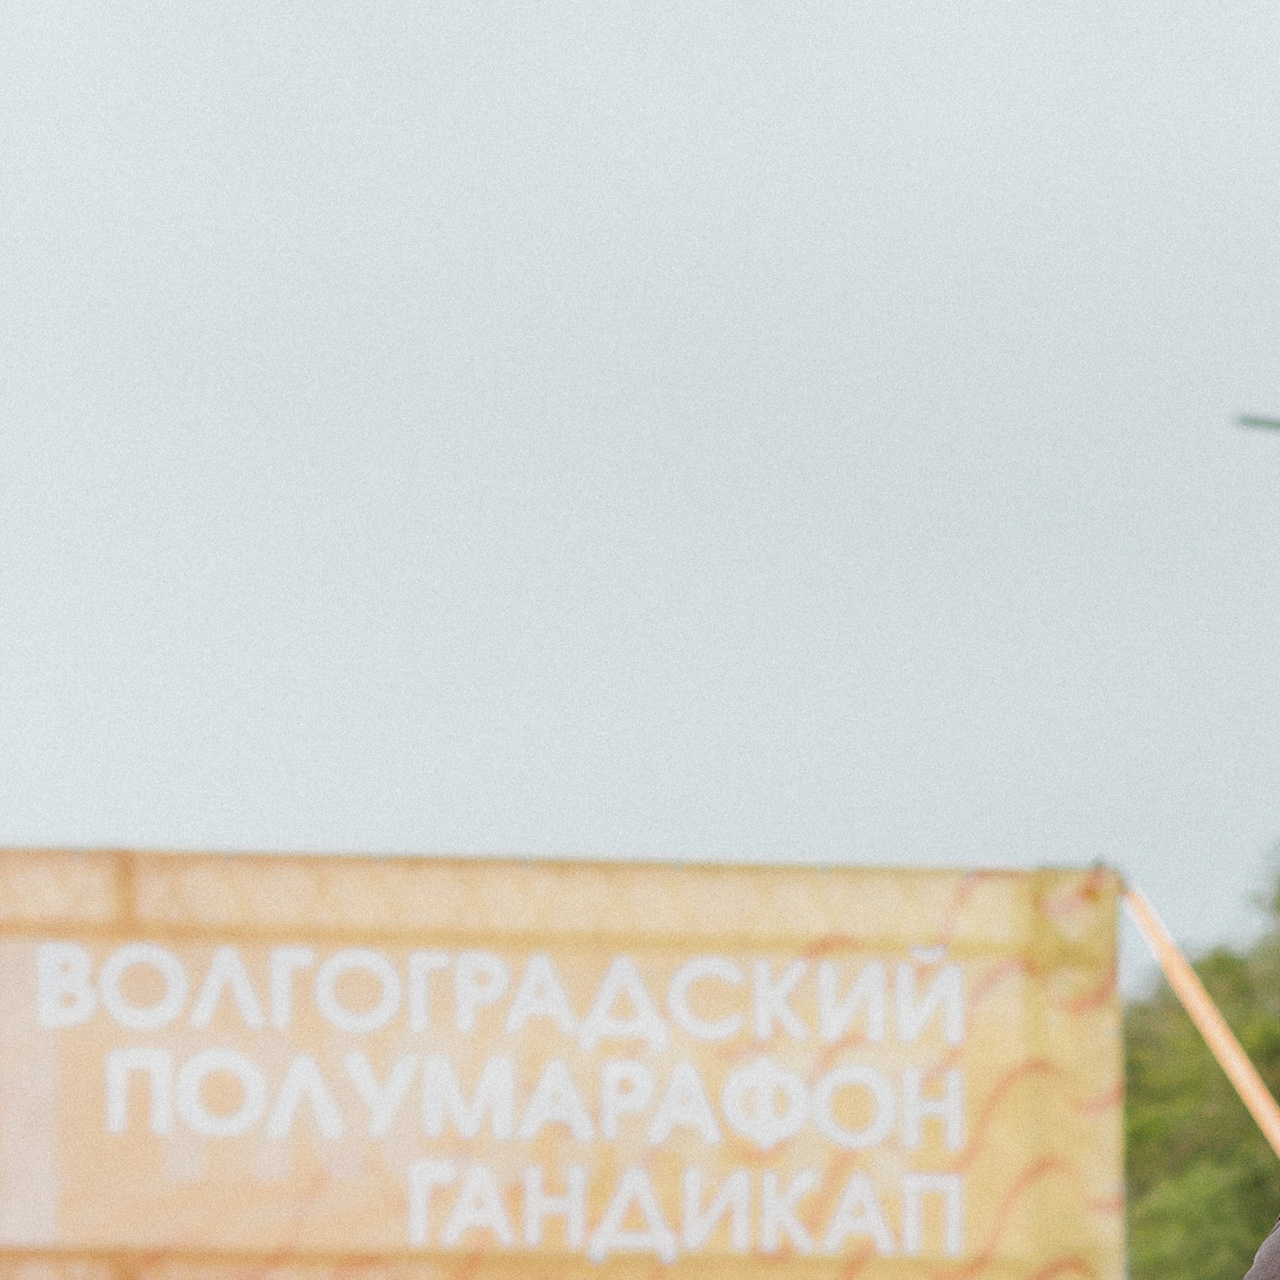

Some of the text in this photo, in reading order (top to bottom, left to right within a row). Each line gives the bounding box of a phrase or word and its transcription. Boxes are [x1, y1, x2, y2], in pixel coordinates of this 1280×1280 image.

[37, 942, 964, 1053] ВОЛГОГРАДСКИЙ
[105, 1048, 964, 1150] ПОЛУМАРАФОН
[408, 1159, 964, 1264] ГАНДИКАП
